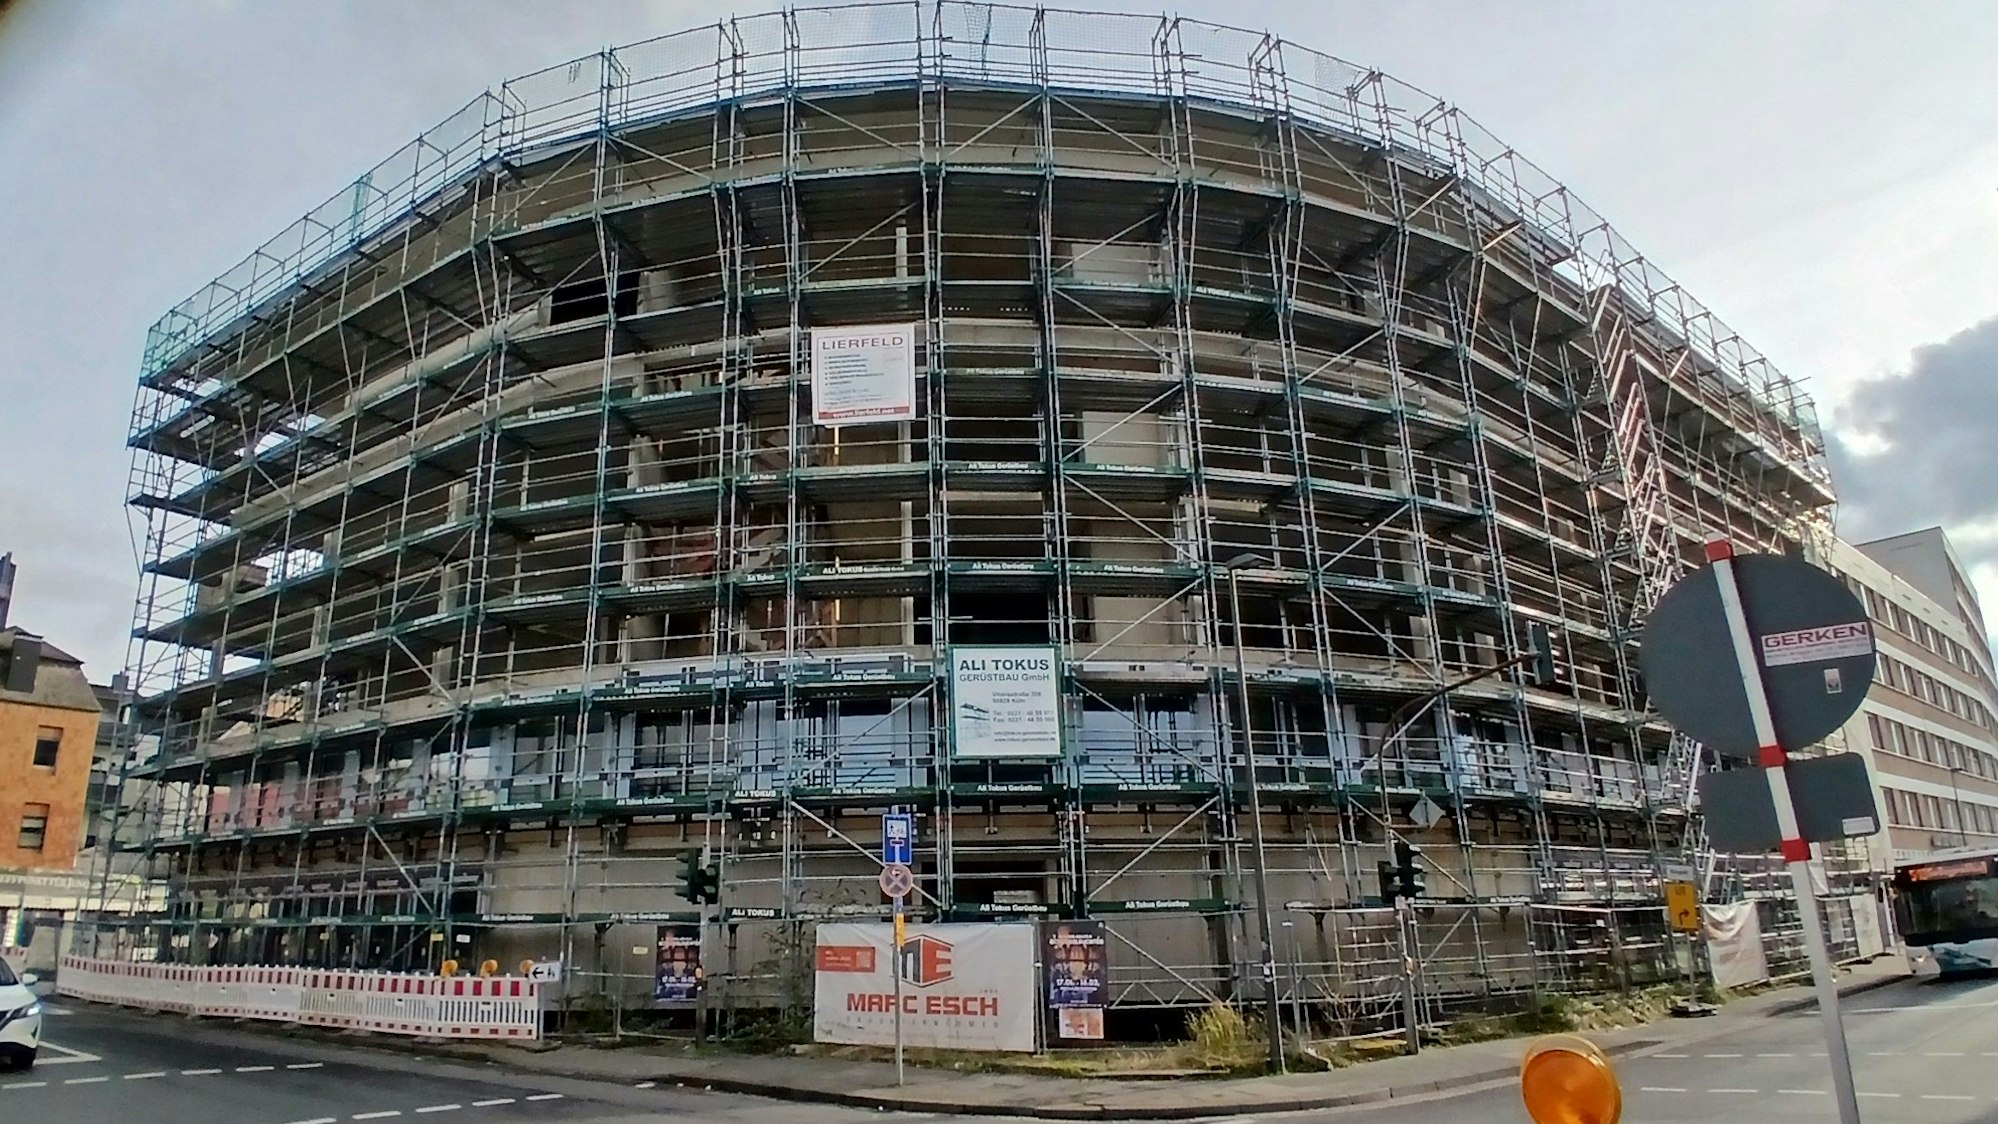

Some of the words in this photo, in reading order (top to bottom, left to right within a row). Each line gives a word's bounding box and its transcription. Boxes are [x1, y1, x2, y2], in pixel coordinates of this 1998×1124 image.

[822, 336, 904, 350] LIERFELD
[822, 567, 836, 575] ALI
[1763, 624, 1868, 649] GERKEN
[959, 659, 986, 671] ALI
[991, 659, 1050, 670] TOKUS
[959, 672, 1019, 682] GERÜSTBAU
[1021, 673, 1049, 681] GmbH
[980, 903, 991, 912] Ali
[990, 903, 1012, 912] Tokus
[846, 992, 918, 1015] MARC
[925, 995, 998, 1017] ESCH
